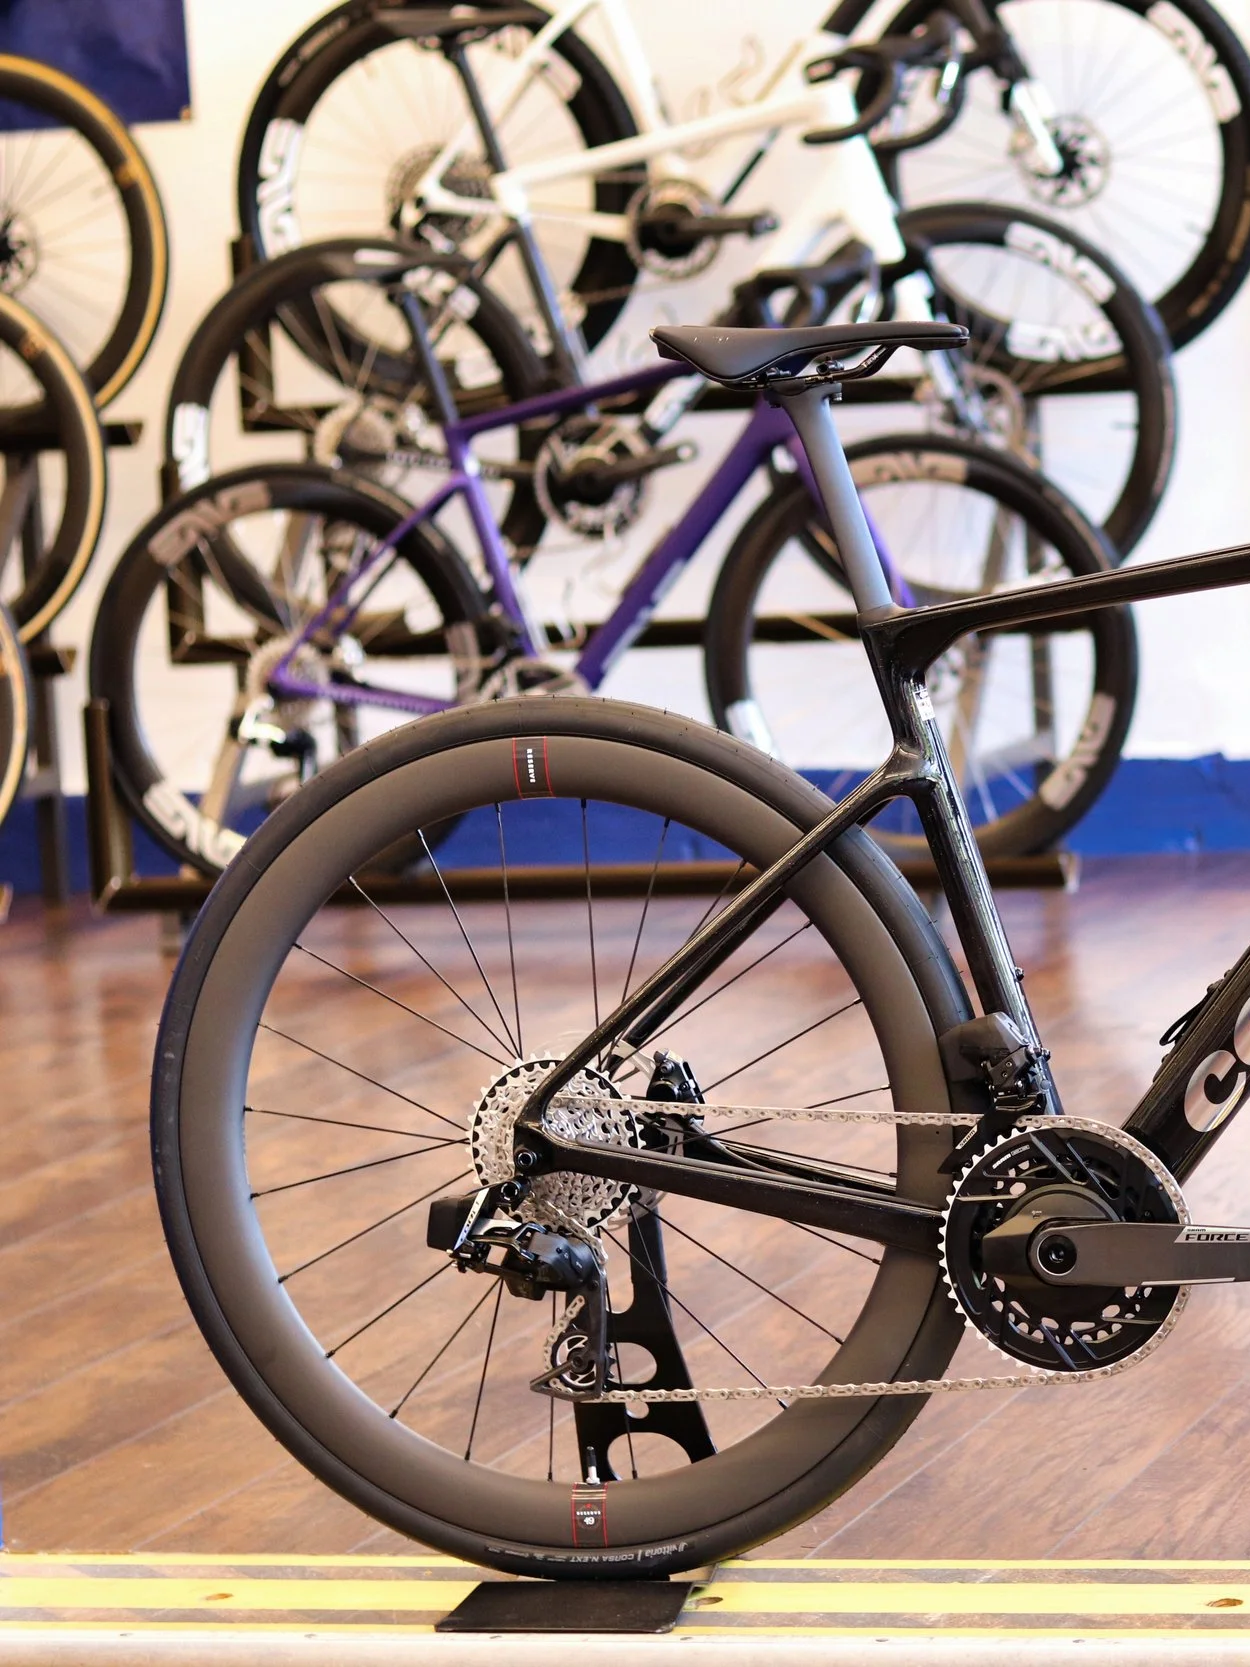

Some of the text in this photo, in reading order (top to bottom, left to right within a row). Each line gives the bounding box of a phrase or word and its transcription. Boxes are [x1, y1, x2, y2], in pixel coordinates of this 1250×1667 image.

[1185, 1233, 1249, 1241] FORCE
[583, 1516, 595, 1525] 49
[570, 1555, 599, 1563] N.EXT
[602, 1553, 634, 1562] CORSA
